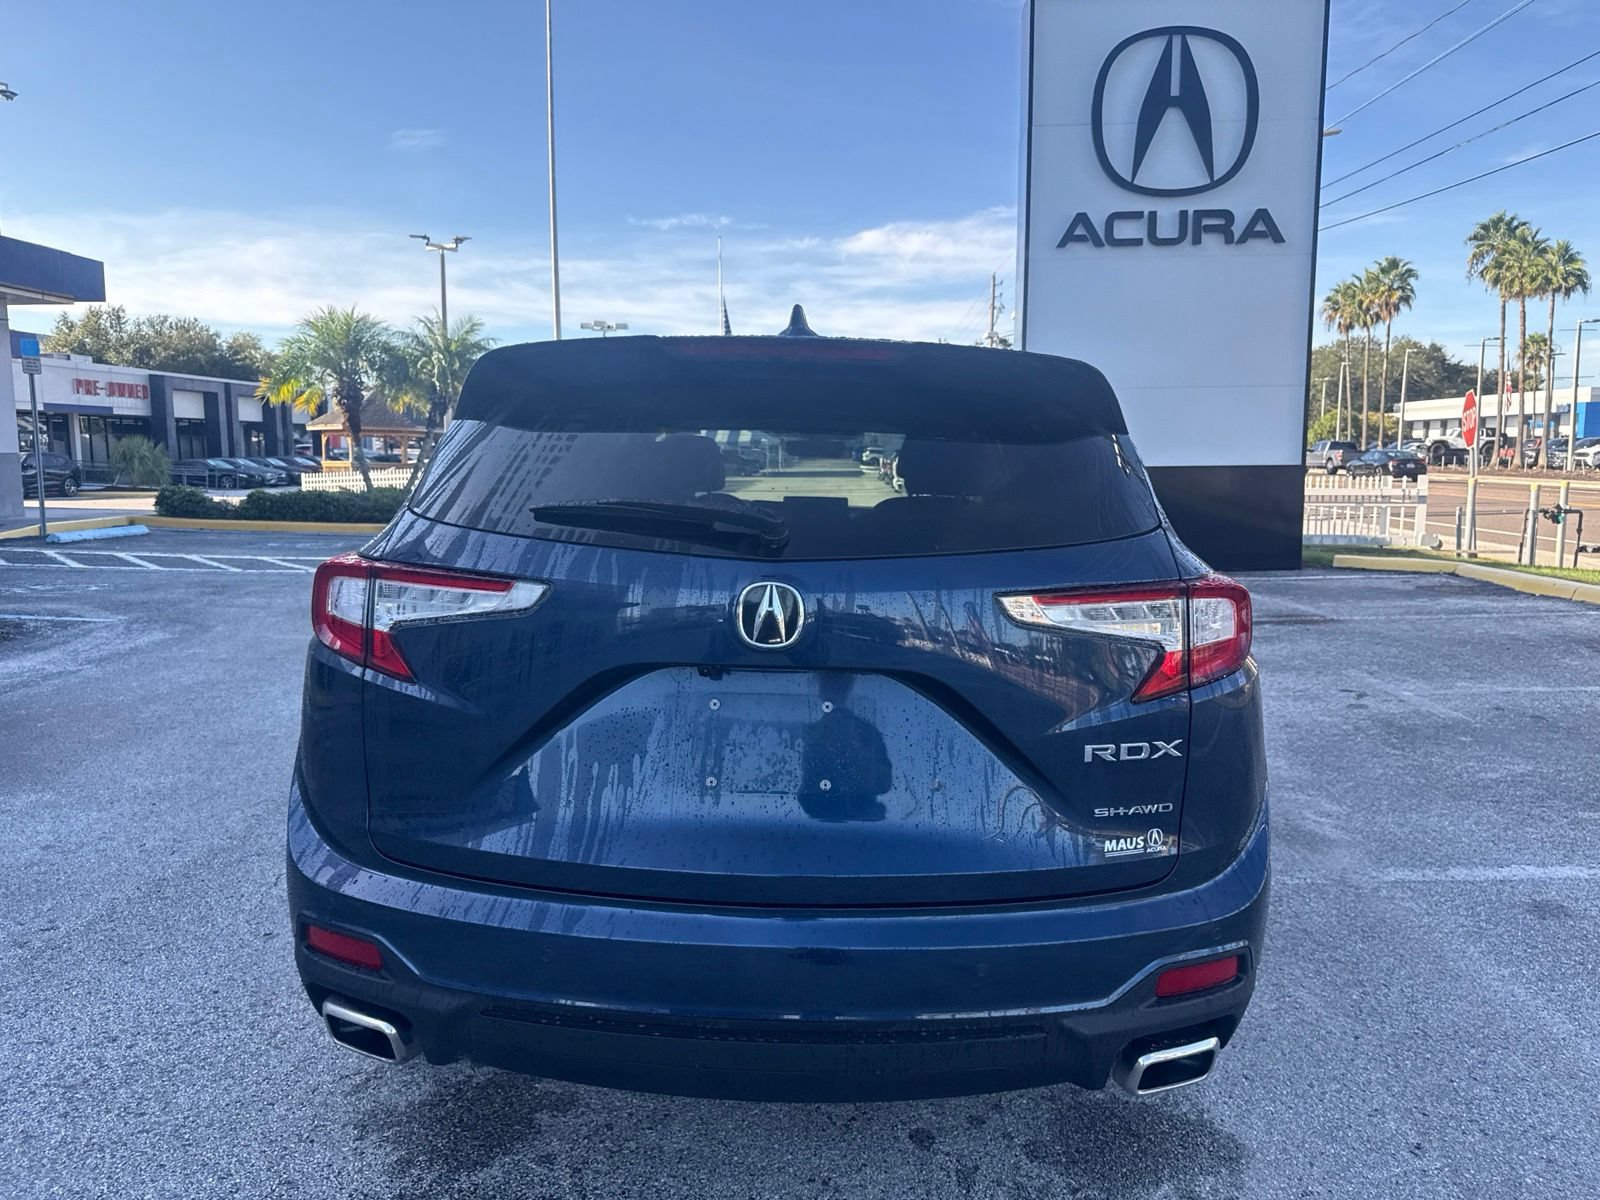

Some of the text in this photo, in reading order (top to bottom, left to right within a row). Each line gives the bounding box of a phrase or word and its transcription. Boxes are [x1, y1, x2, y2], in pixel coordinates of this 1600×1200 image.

[1056, 208, 1286, 248] ACURA
[73, 378, 149, 400] PRE-OWNED
[1462, 406, 1476, 433] STOP
[1083, 739, 1183, 763] RDX
[1094, 803, 1173, 818] SH-AWD
[1104, 836, 1144, 853] MAUS
